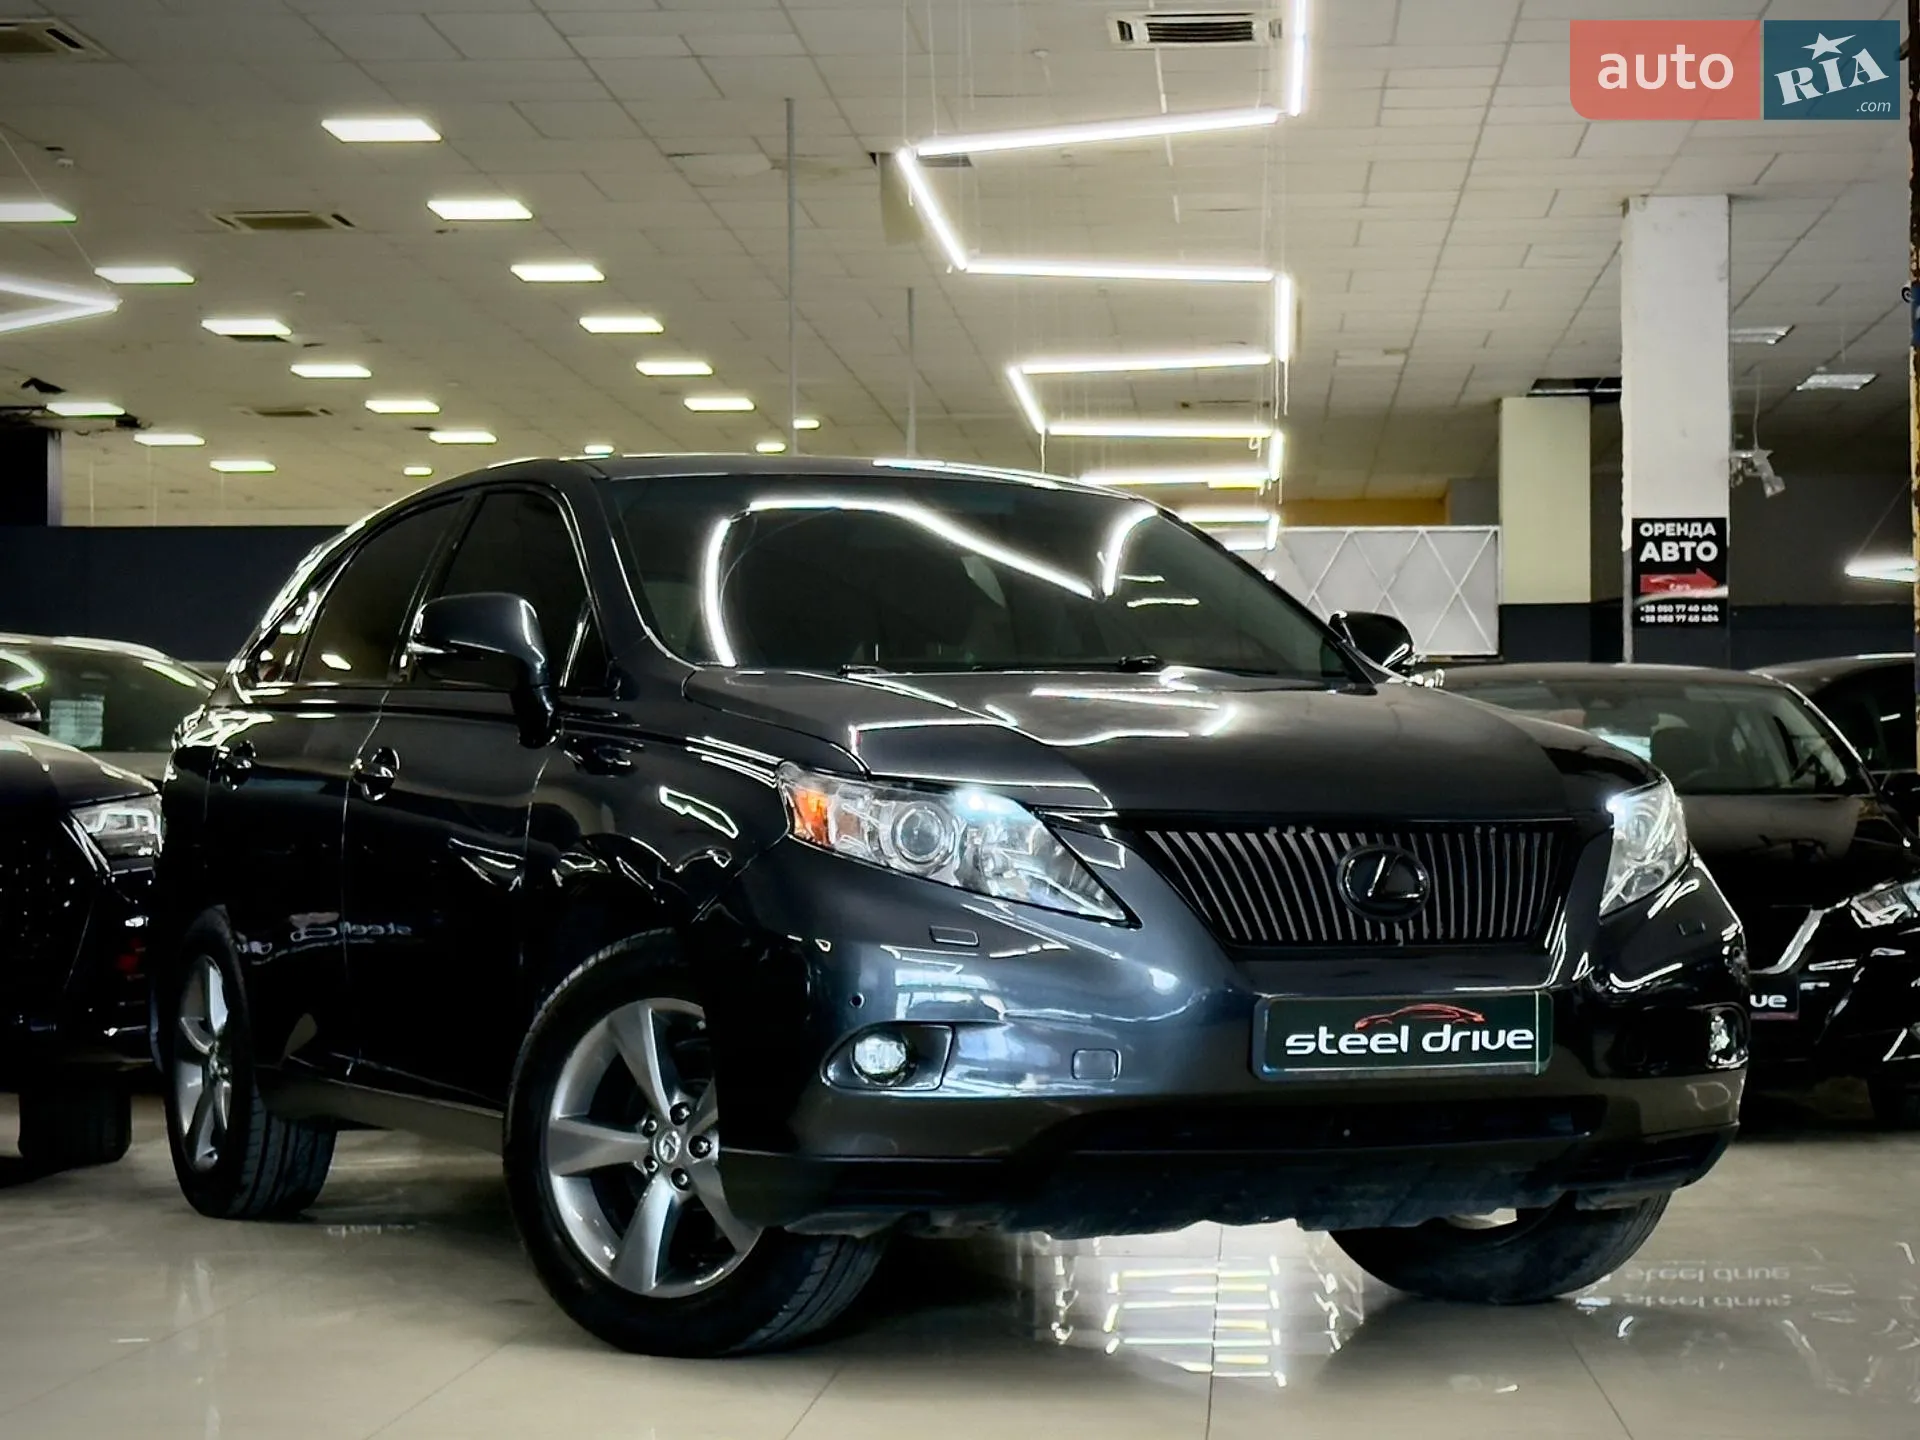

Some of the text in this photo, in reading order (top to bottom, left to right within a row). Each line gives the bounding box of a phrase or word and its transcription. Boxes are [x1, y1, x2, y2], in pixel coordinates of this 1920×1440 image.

[1639, 521, 1717, 538] ОРЕНДА
[1639, 540, 1719, 562] АВТО
[1675, 604, 1687, 613] 77
[1675, 614, 1687, 623] 77
[1285, 1024, 1535, 1055] steel drive
